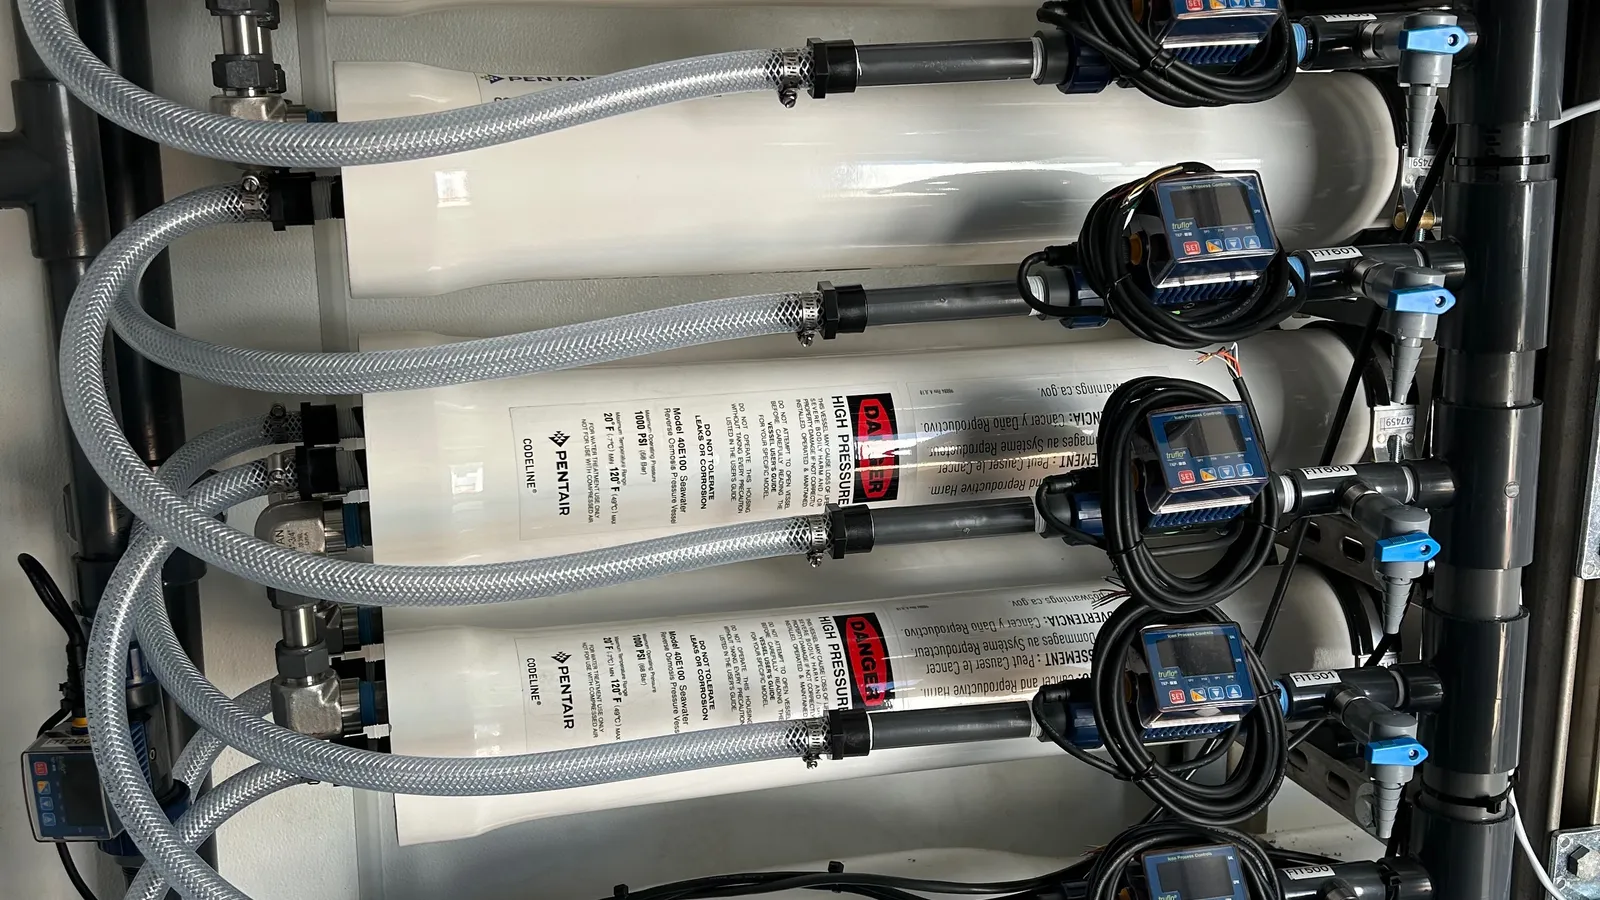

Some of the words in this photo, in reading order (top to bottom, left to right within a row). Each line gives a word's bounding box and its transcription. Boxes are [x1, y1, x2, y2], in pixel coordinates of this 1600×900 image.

[1413, 158, 1433, 167] 7459
[1311, 247, 1356, 257] FIT601
[635, 411, 647, 430] 1000
[673, 408, 684, 434] Model
[731, 403, 741, 430] WITHOUT
[771, 401, 780, 424] BEFORE
[831, 395, 848, 428] HIGH
[1022, 413, 1028, 425] y
[1031, 413, 1065, 427] Cáncer
[664, 408, 674, 436] Reverse
[695, 415, 704, 442] LEAKS
[704, 424, 712, 437] DO
[803, 399, 813, 428] PROPERTY
[808, 429, 816, 455] DAMAGE
[810, 398, 820, 424] SEVERE
[815, 427, 823, 452] BODILY
[994, 416, 1018, 431] Daño
[1386, 417, 1412, 427] 47459
[638, 433, 648, 446] PSI
[767, 422, 775, 446] VESSEL
[1047, 438, 1058, 448] au
[590, 436, 598, 456] WATER
[648, 434, 656, 460] Operating
[668, 438, 677, 471] Osmosis
[678, 437, 688, 472] 40E100
[699, 444, 706, 456] OR
[706, 439, 714, 456] NOT
[744, 434, 752, 464] OPERATE
[775, 429, 784, 464] CAREFULLY
[863, 404, 885, 494] DAER
[1000, 436, 1044, 454] Système
[838, 434, 851, 506] PRESSURE
[938, 462, 971, 475] Cancer
[976, 461, 985, 473] le
[989, 459, 1024, 472] Causer
[1027, 457, 1050, 470] Peut
[1303, 465, 1350, 475] FIT600
[556, 450, 570, 516] PENTAIR
[670, 472, 678, 504] Pressure
[700, 459, 708, 510] CORROSION
[928, 484, 958, 496] Harm.
[961, 478, 1026, 494] Reproductive
[1030, 478, 1042, 490] nd
[679, 476, 688, 513] Seawater
[784, 490, 792, 510] VESSEL
[670, 505, 678, 524] Vessel
[818, 616, 837, 640] HIGH
[971, 620, 997, 635] Daño
[1008, 616, 1041, 629] Cáncer
[1044, 611, 1112, 627] VERTENCIA:
[669, 631, 680, 650] Model
[690, 634, 700, 654] LEAKS
[699, 640, 706, 650] DO
[982, 636, 1025, 652] Système
[1028, 637, 1039, 647] au
[1041, 631, 1095, 648] Dommages
[636, 649, 646, 660] PSI
[695, 656, 702, 668] OR
[701, 652, 710, 668] NOT
[738, 647, 747, 672] OPERATE
[851, 621, 881, 702] DANGER
[976, 656, 1010, 671] Causer
[1013, 653, 1034, 668] Peut
[618, 653, 627, 680] Temperature
[674, 652, 686, 682] 40E100
[757, 657, 766, 684] SPECIFIC
[759, 637, 768, 656] VESSEL
[764, 657, 772, 680] USER'S
[768, 680, 776, 700] GUIDE
[811, 662, 819, 682] HARM
[926, 661, 960, 676] Cancer
[963, 659, 972, 672] le
[650, 671, 658, 694] Pressure
[665, 652, 675, 681] Osmosis
[670, 682, 679, 715] Pressure
[734, 667, 742, 685] EVERY
[820, 676, 828, 692] LOSS
[1021, 677, 1038, 690] and
[1293, 671, 1336, 682] FIT501
[593, 671, 602, 702] TREATMENT
[697, 669, 708, 721] CORROSION
[705, 669, 716, 710] TOLERATE
[954, 680, 1016, 696] Reproductive
[558, 666, 575, 730] PENTAIR
[588, 687, 598, 728] COMPRESSED
[679, 685, 690, 726] Seawater
[1286, 866, 1330, 876] FIT500
